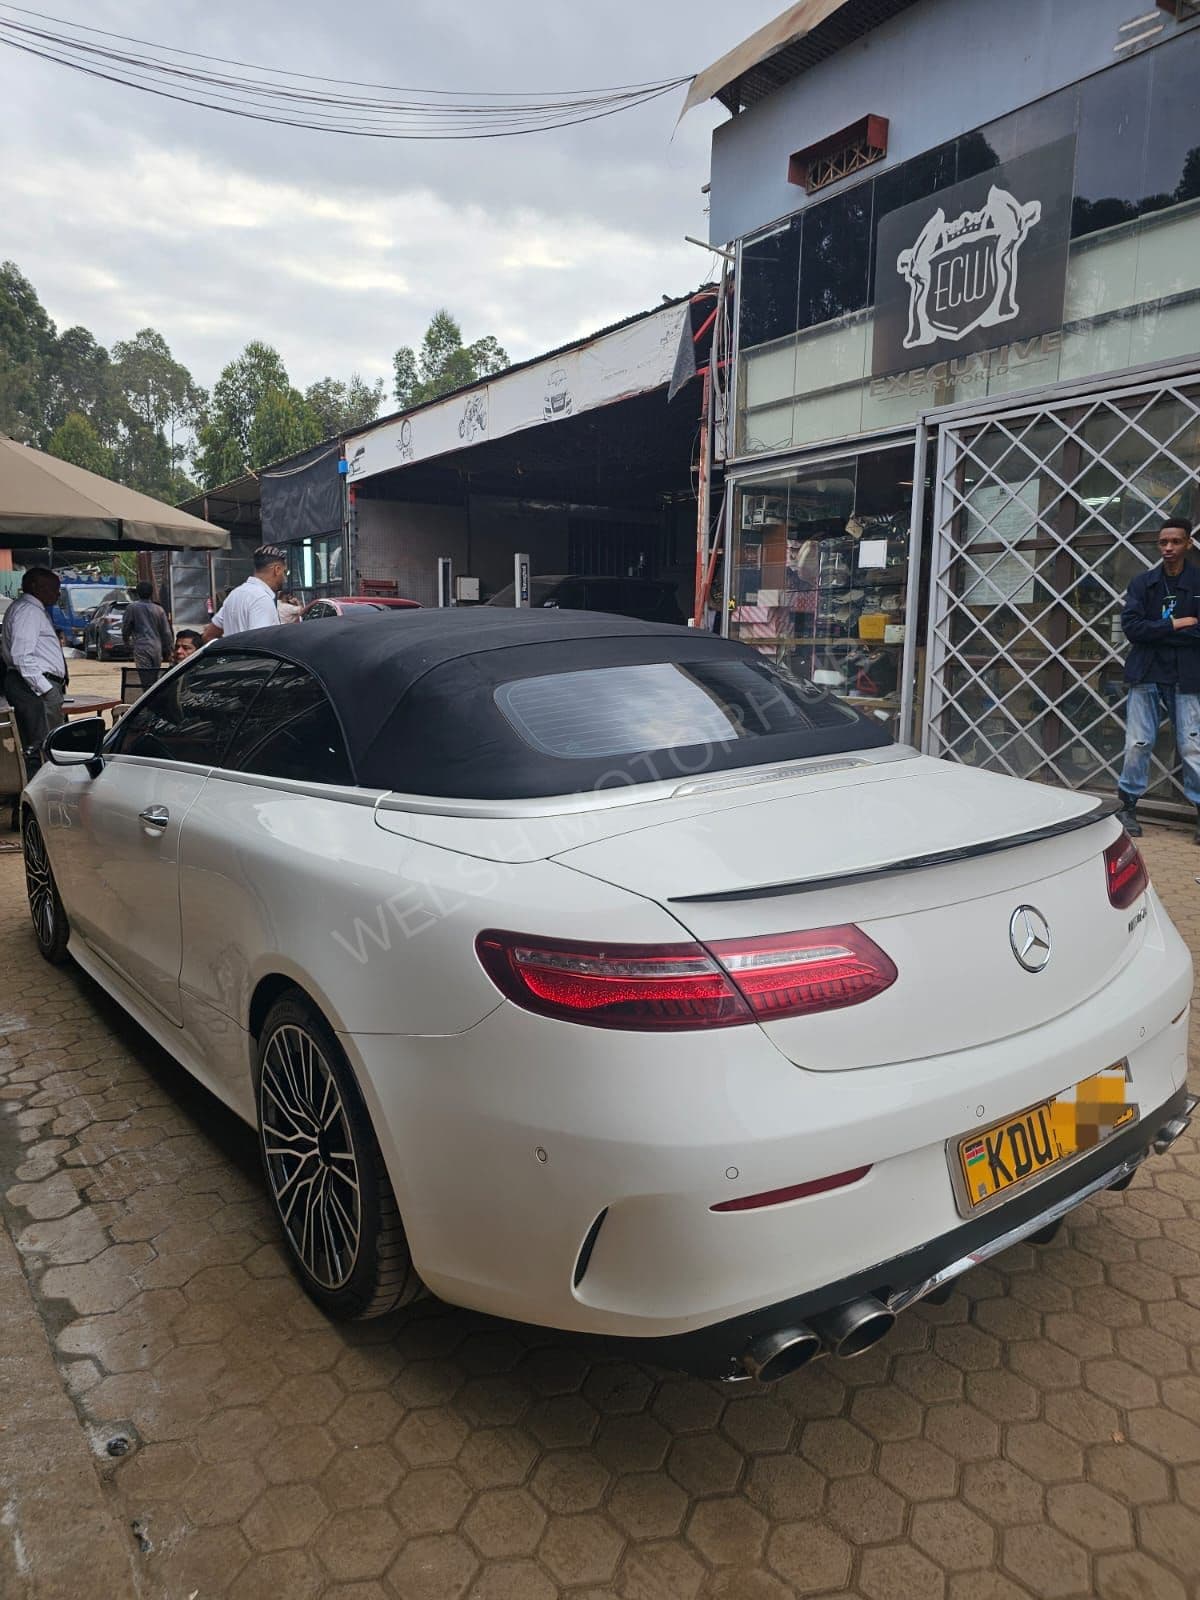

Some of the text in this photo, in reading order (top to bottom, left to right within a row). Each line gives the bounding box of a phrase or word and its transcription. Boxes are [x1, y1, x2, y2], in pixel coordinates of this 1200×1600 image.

[934, 246, 990, 312] ECW
[868, 331, 1062, 398] EXECUTIVE
[944, 366, 1009, 389] WORLD
[985, 1109, 1053, 1190] KDU
